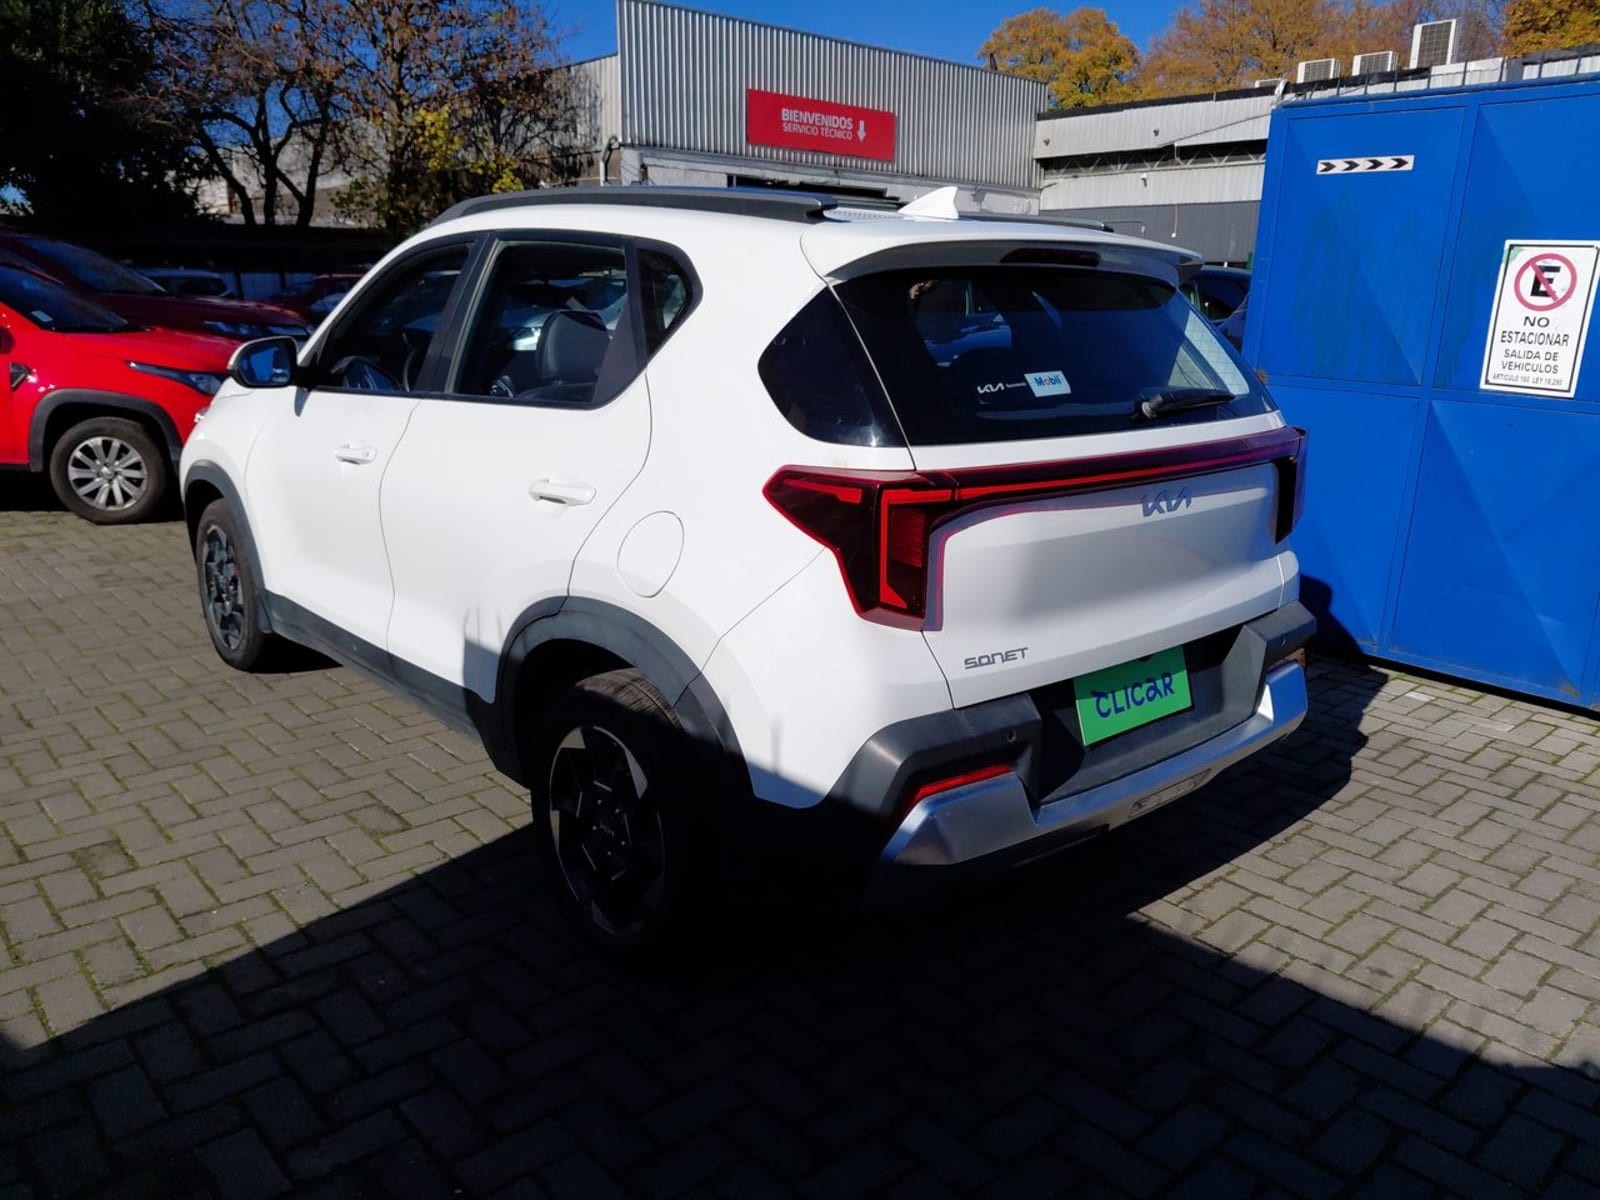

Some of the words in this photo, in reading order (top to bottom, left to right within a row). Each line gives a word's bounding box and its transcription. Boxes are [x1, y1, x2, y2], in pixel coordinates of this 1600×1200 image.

[781, 108, 853, 130] BIENVENIDOS
[782, 122, 819, 136] SERVICIO
[1530, 265, 1561, 298] E
[1523, 316, 1550, 328] NO
[1500, 330, 1570, 346] ESTACIONAR
[1503, 349, 1541, 361] SALIDA
[1544, 352, 1559, 362] DE
[1501, 361, 1559, 375] VEHICULOS
[1033, 375, 1063, 387] Mobil
[1532, 376, 1543, 385] LEY
[1141, 486, 1192, 517] KIA
[964, 647, 1029, 670] SONET
